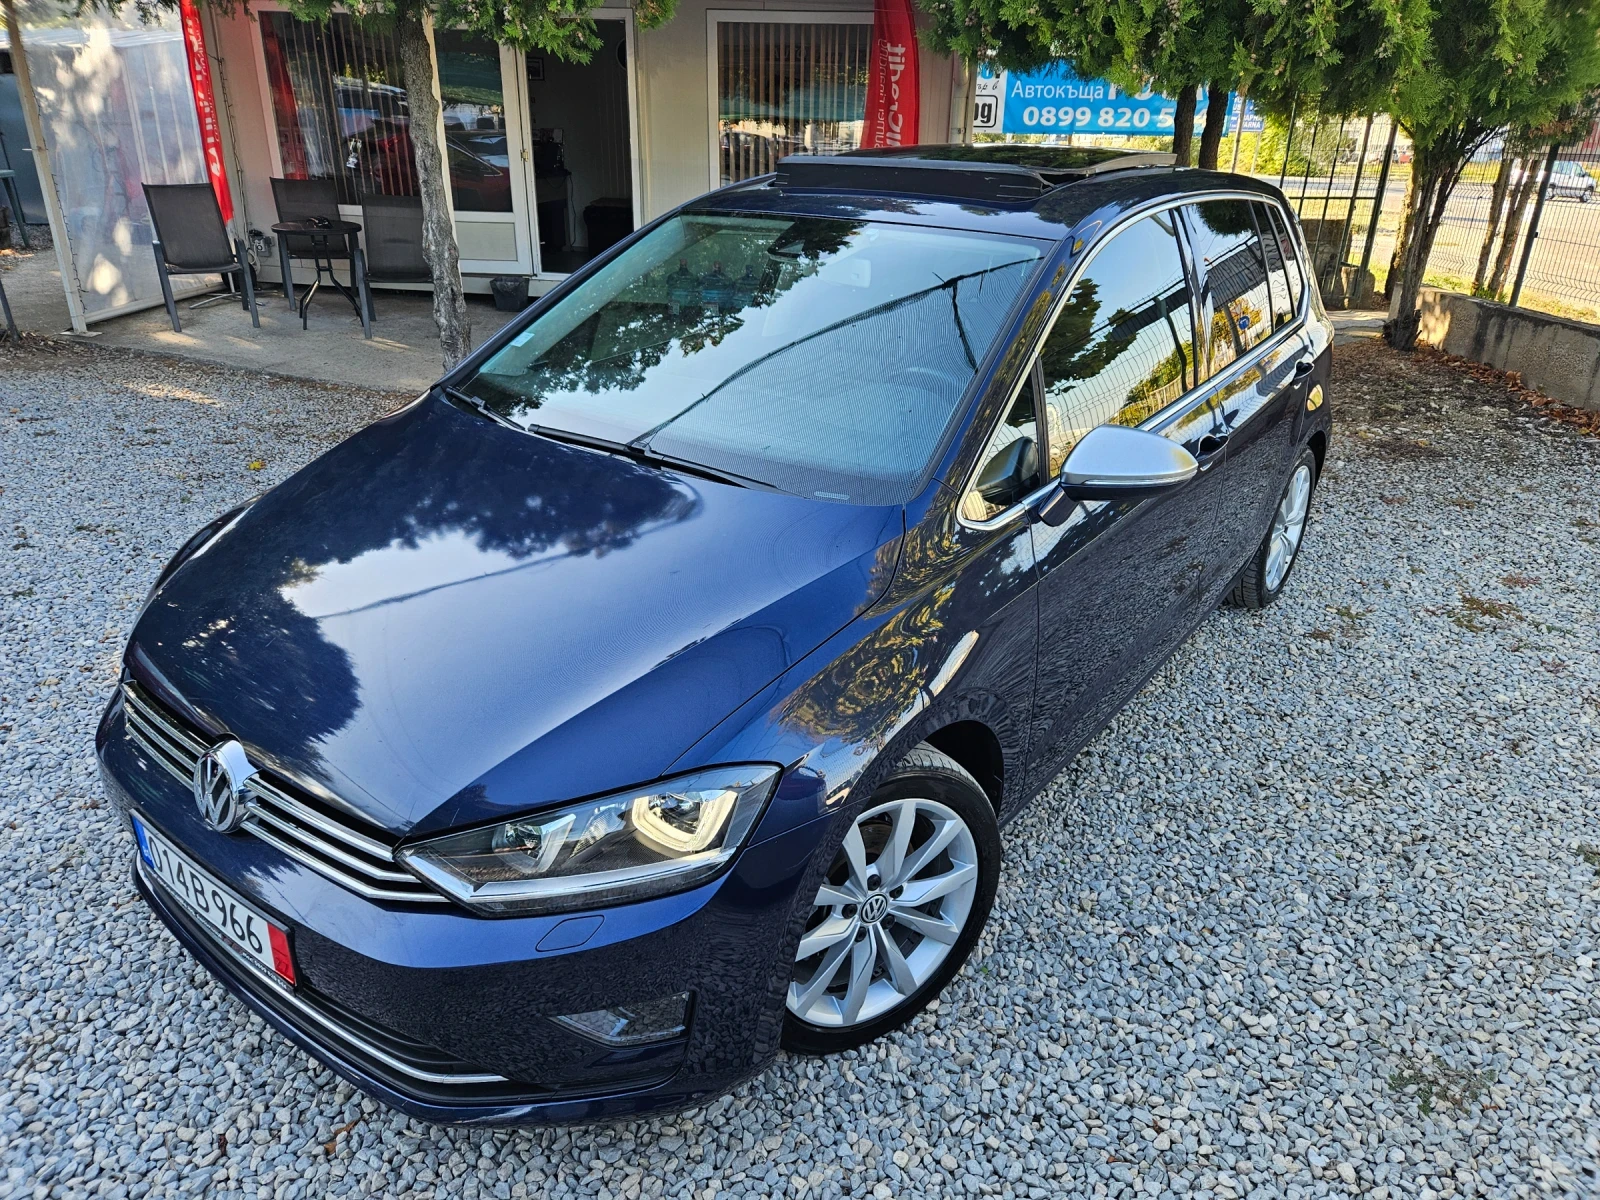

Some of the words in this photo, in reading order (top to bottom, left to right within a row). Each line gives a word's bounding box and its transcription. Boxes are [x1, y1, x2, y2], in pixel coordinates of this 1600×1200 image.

[1011, 81, 1104, 102] Автокъща
[1023, 106, 1091, 127] 0899
[1097, 107, 1150, 128] 820
[1157, 107, 1208, 127] 54
